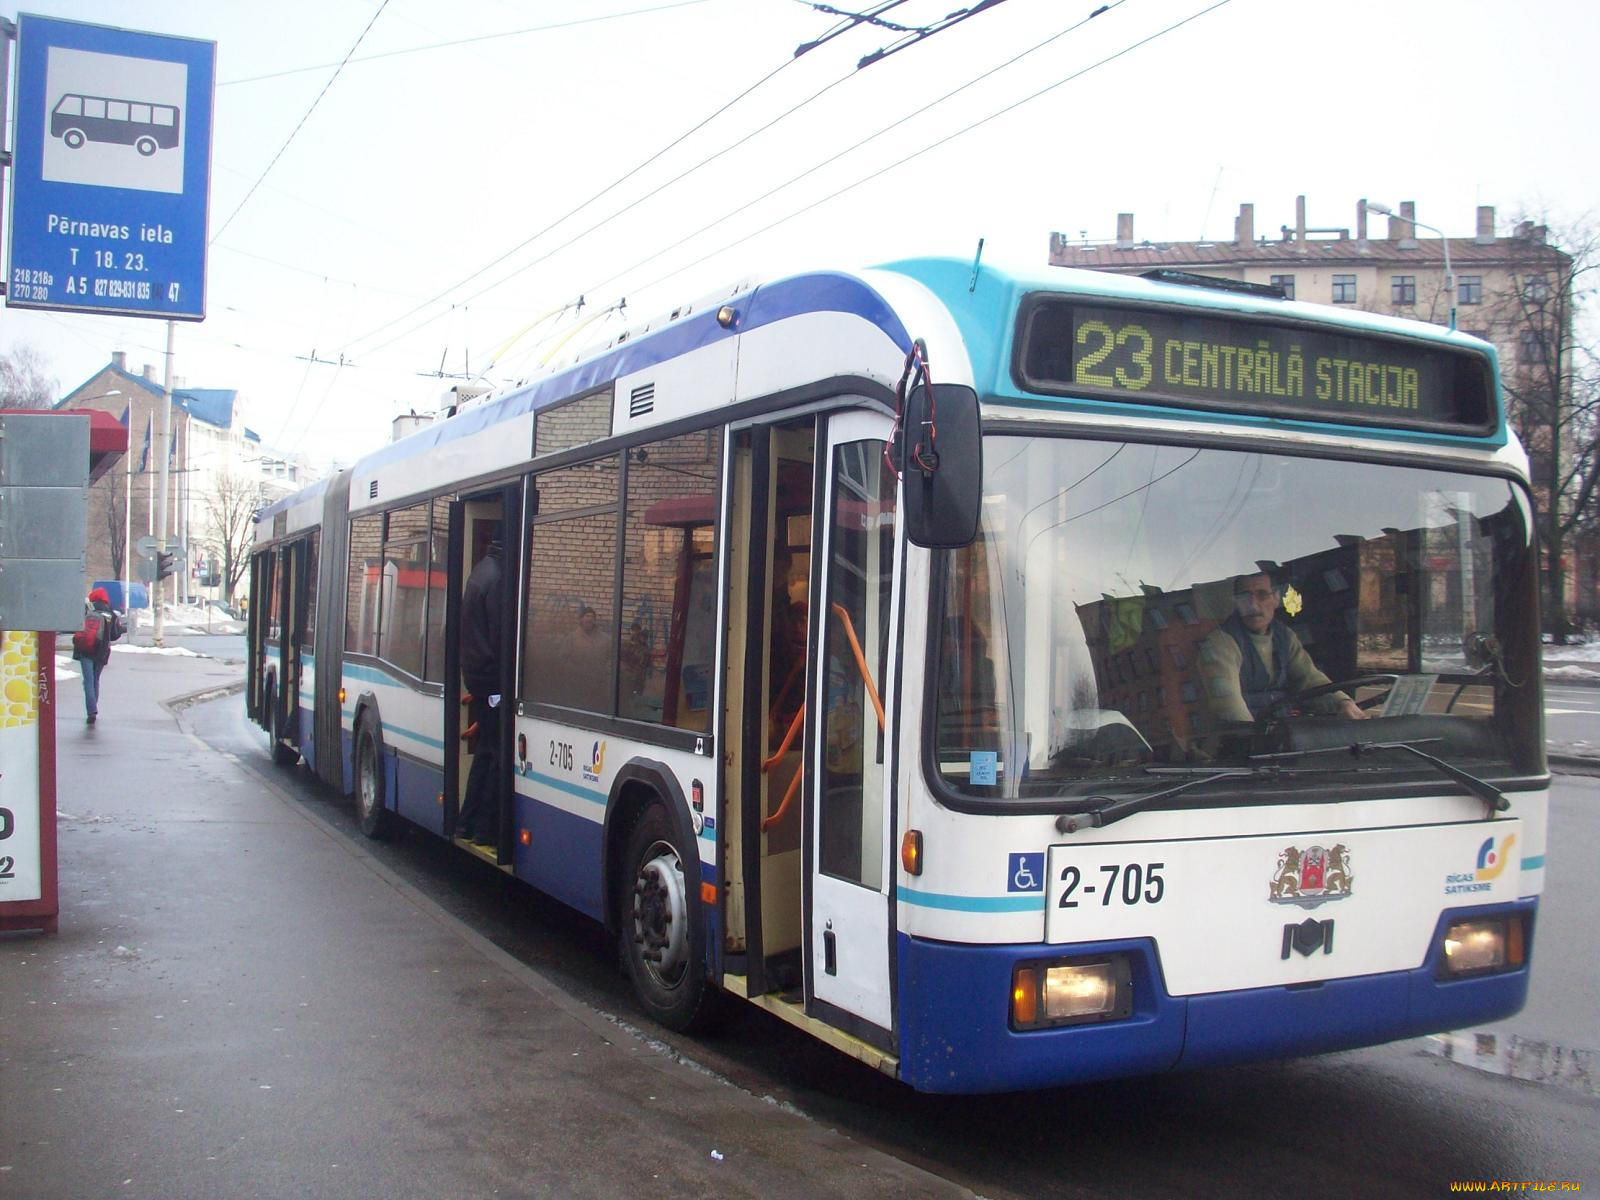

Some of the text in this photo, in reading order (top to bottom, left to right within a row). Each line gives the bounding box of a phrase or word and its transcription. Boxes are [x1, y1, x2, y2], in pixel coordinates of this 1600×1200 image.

[48, 213, 173, 244] Pērnavas iela
[70, 247, 149, 272] T 18. 23.
[14, 267, 54, 286] 218 218a
[94, 278, 108, 297] 827
[137, 281, 150, 300] 835
[168, 282, 180, 303] 47
[14, 284, 48, 301] 270 280
[1076, 320, 1419, 409] 23 CENTRĀLĀ STACIJA
[549, 739, 573, 772] 2-705
[1058, 862, 1165, 909] 2-705
